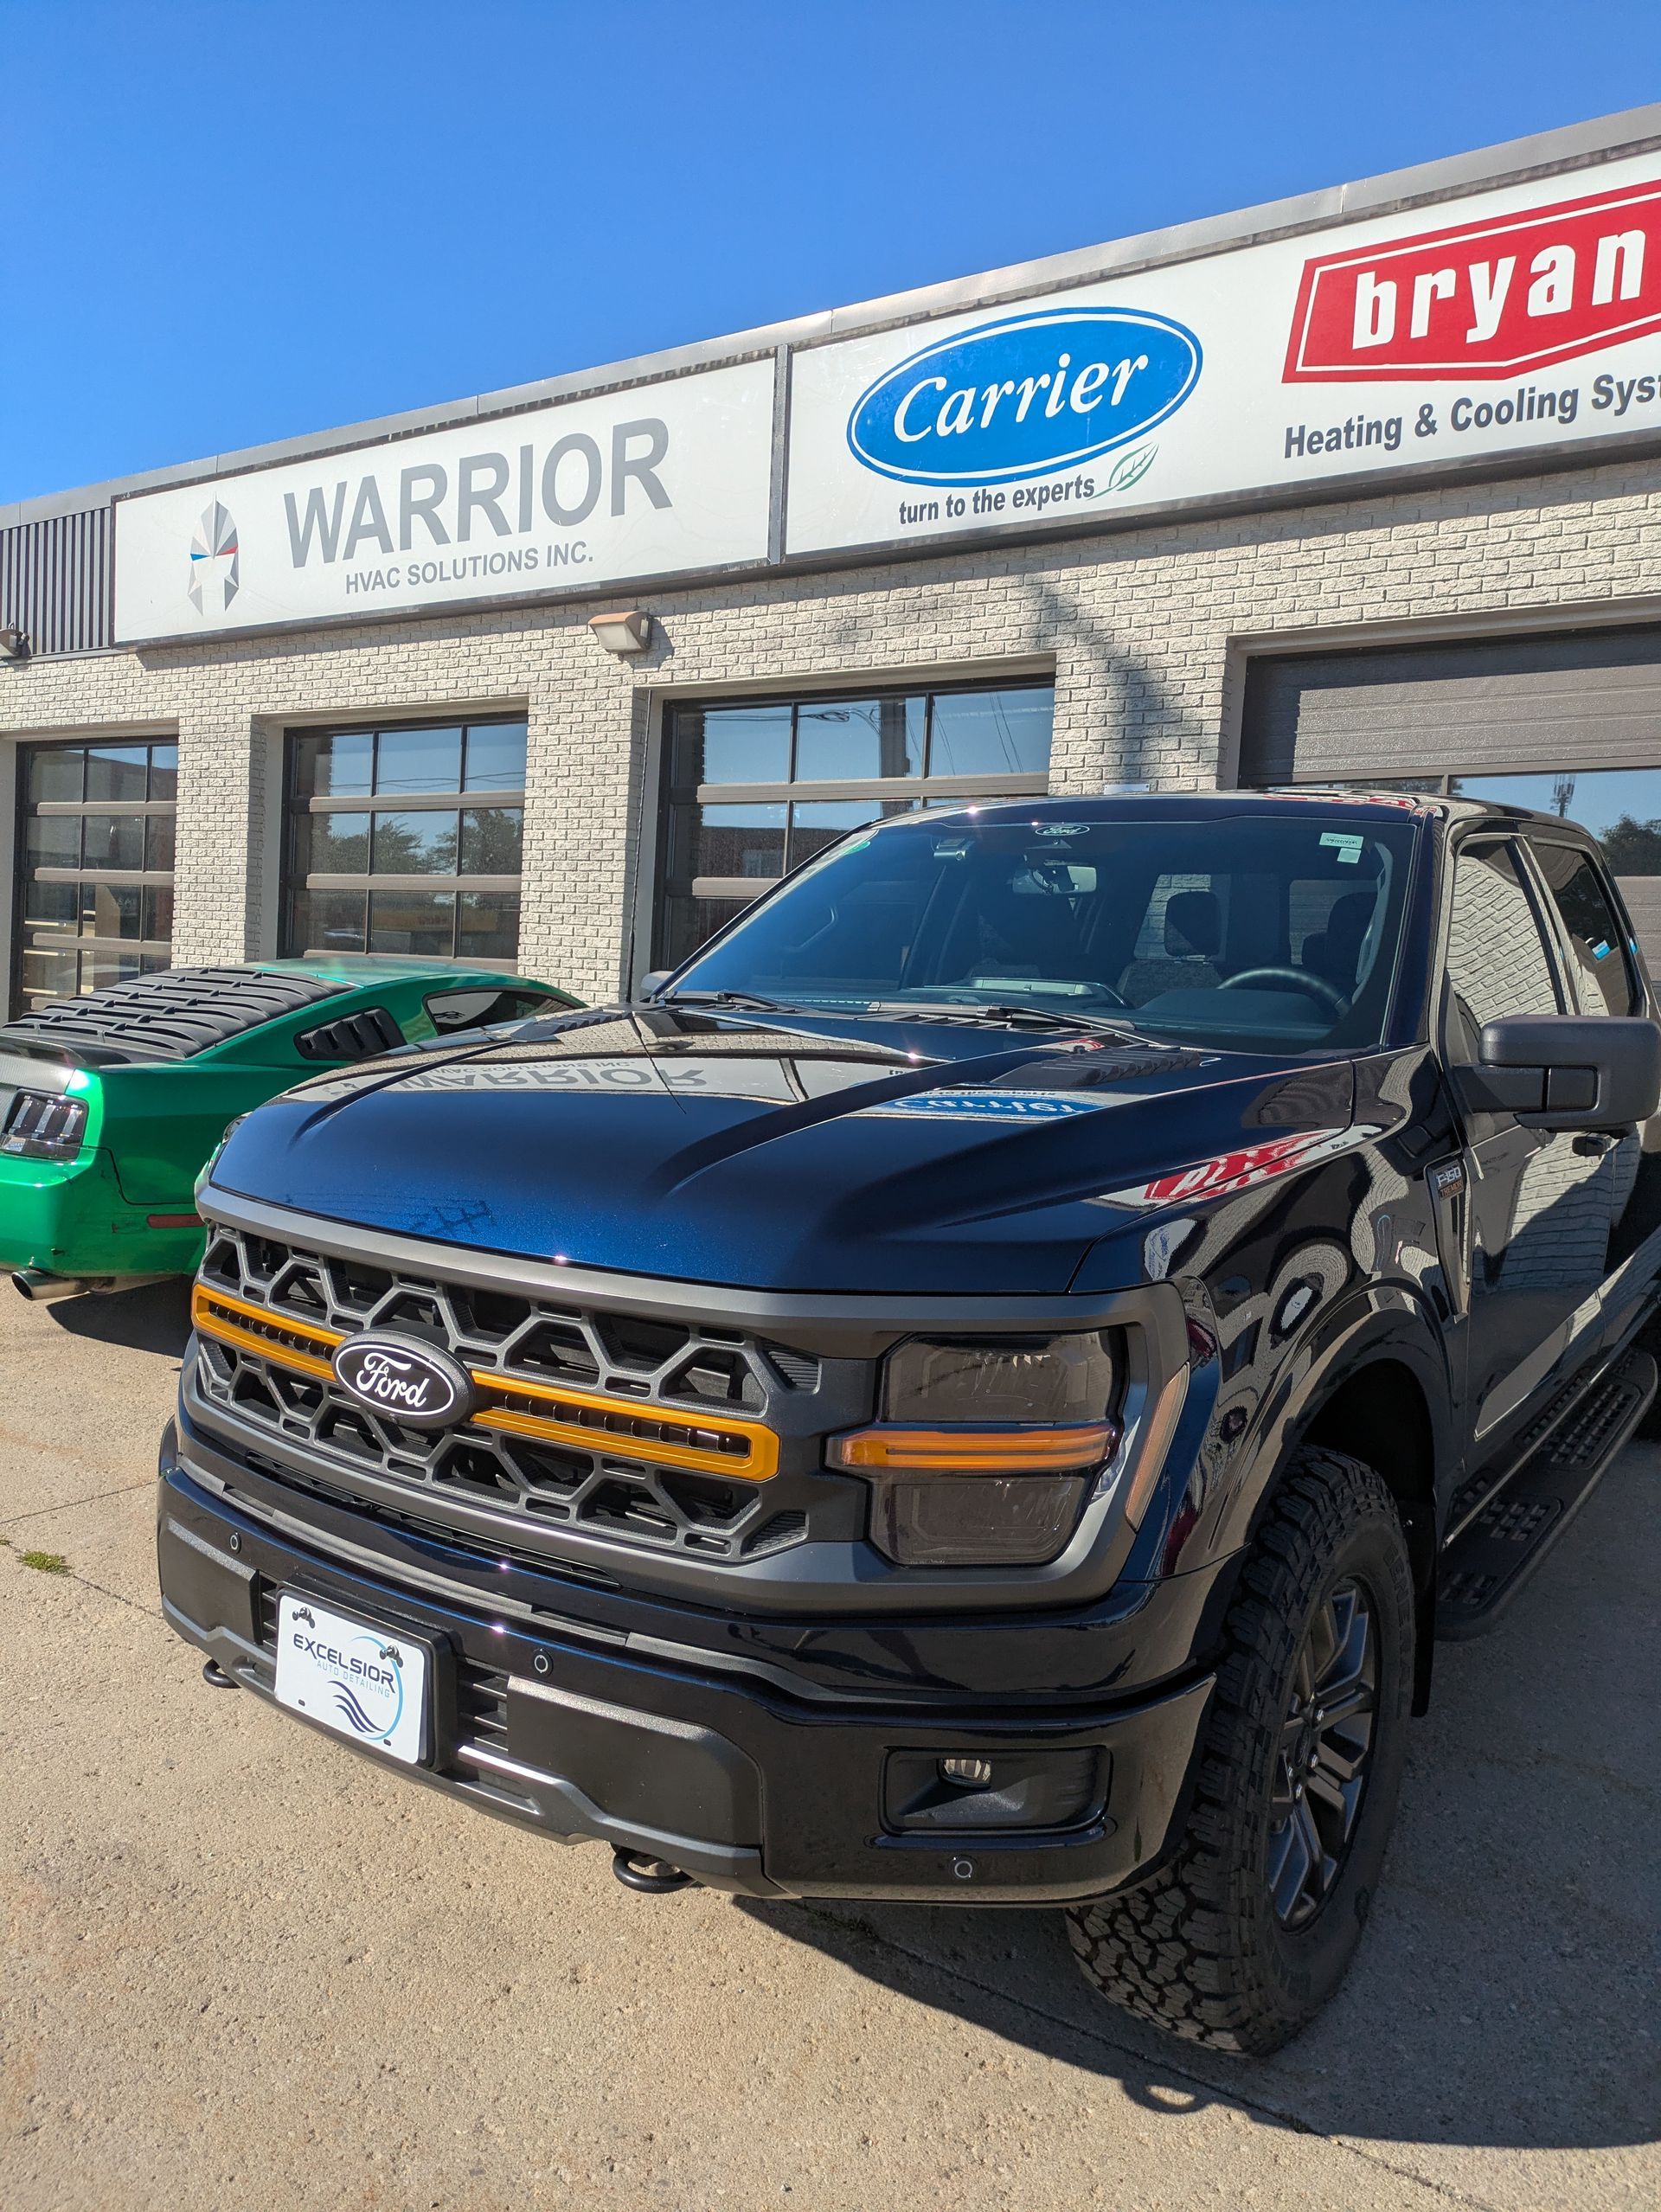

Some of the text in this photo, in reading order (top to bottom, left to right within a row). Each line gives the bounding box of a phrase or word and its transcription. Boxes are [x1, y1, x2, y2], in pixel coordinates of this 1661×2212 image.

[1352, 229, 1646, 349] bryan
[894, 353, 1149, 443] Carrier
[1284, 372, 1661, 458] Heating & Cooling Sys
[284, 418, 672, 568] WARRIOR
[899, 474, 1095, 525] turn to the experts
[346, 541, 594, 595] HVAC SOLUTIONS INC.
[356, 1352, 430, 1407] Ford
[293, 1633, 396, 1694] EXCELSIOR
[317, 1659, 390, 1698] AUTO DETAILING
